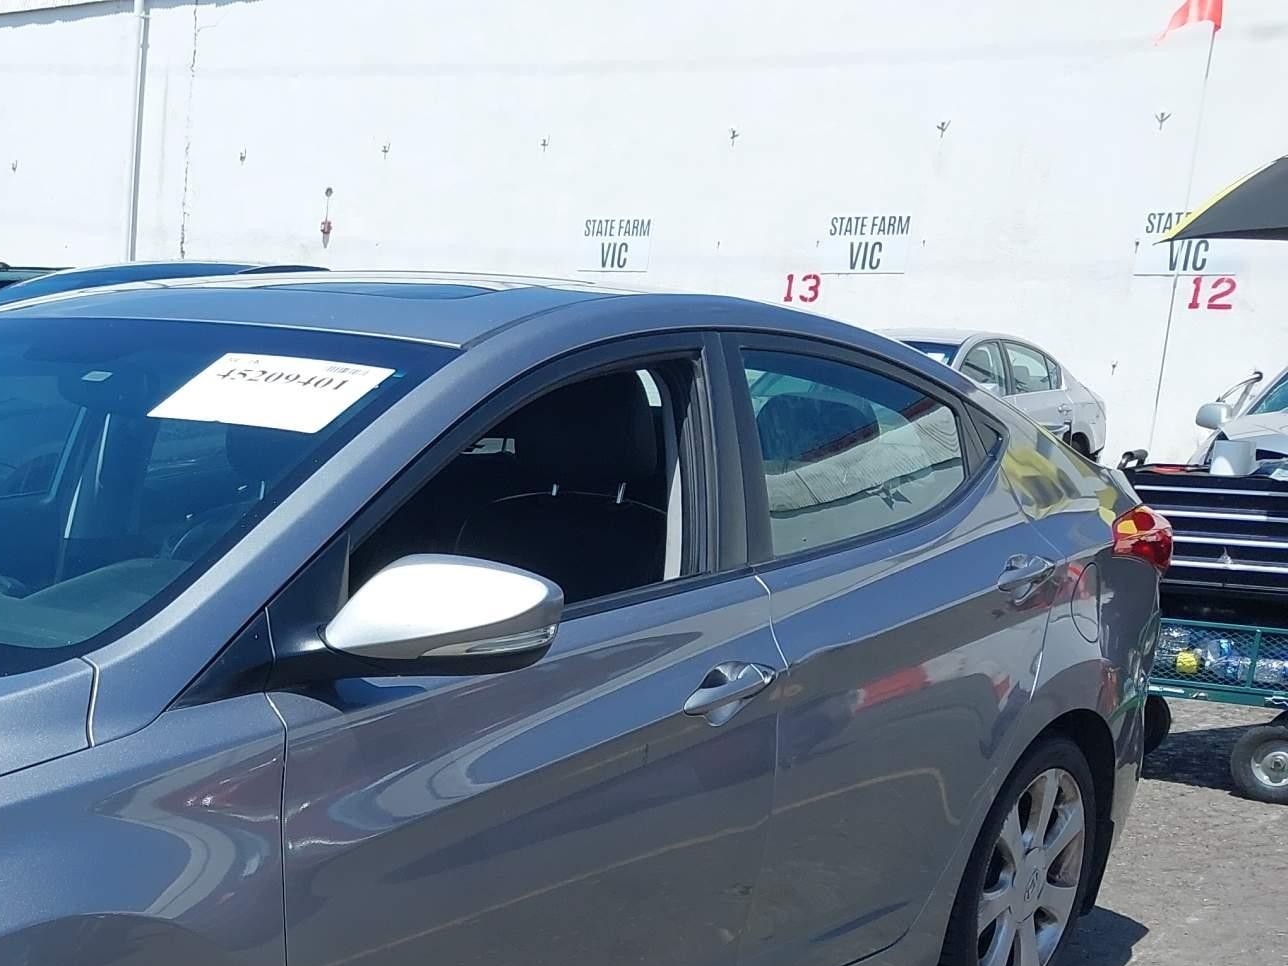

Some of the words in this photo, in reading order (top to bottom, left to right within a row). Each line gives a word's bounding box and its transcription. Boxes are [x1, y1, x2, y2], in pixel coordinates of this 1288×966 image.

[584, 219, 616, 237] STATE
[617, 219, 652, 237] FARM
[829, 216, 868, 236] STATE
[870, 215, 911, 236] FARM
[1145, 212, 1192, 234] STAT
[601, 242, 628, 268] VIC
[849, 241, 883, 270] VIC
[1168, 239, 1210, 271] VIC
[783, 273, 821, 303] 13
[1188, 277, 1237, 310] 12
[217, 369, 348, 390] 45209401
